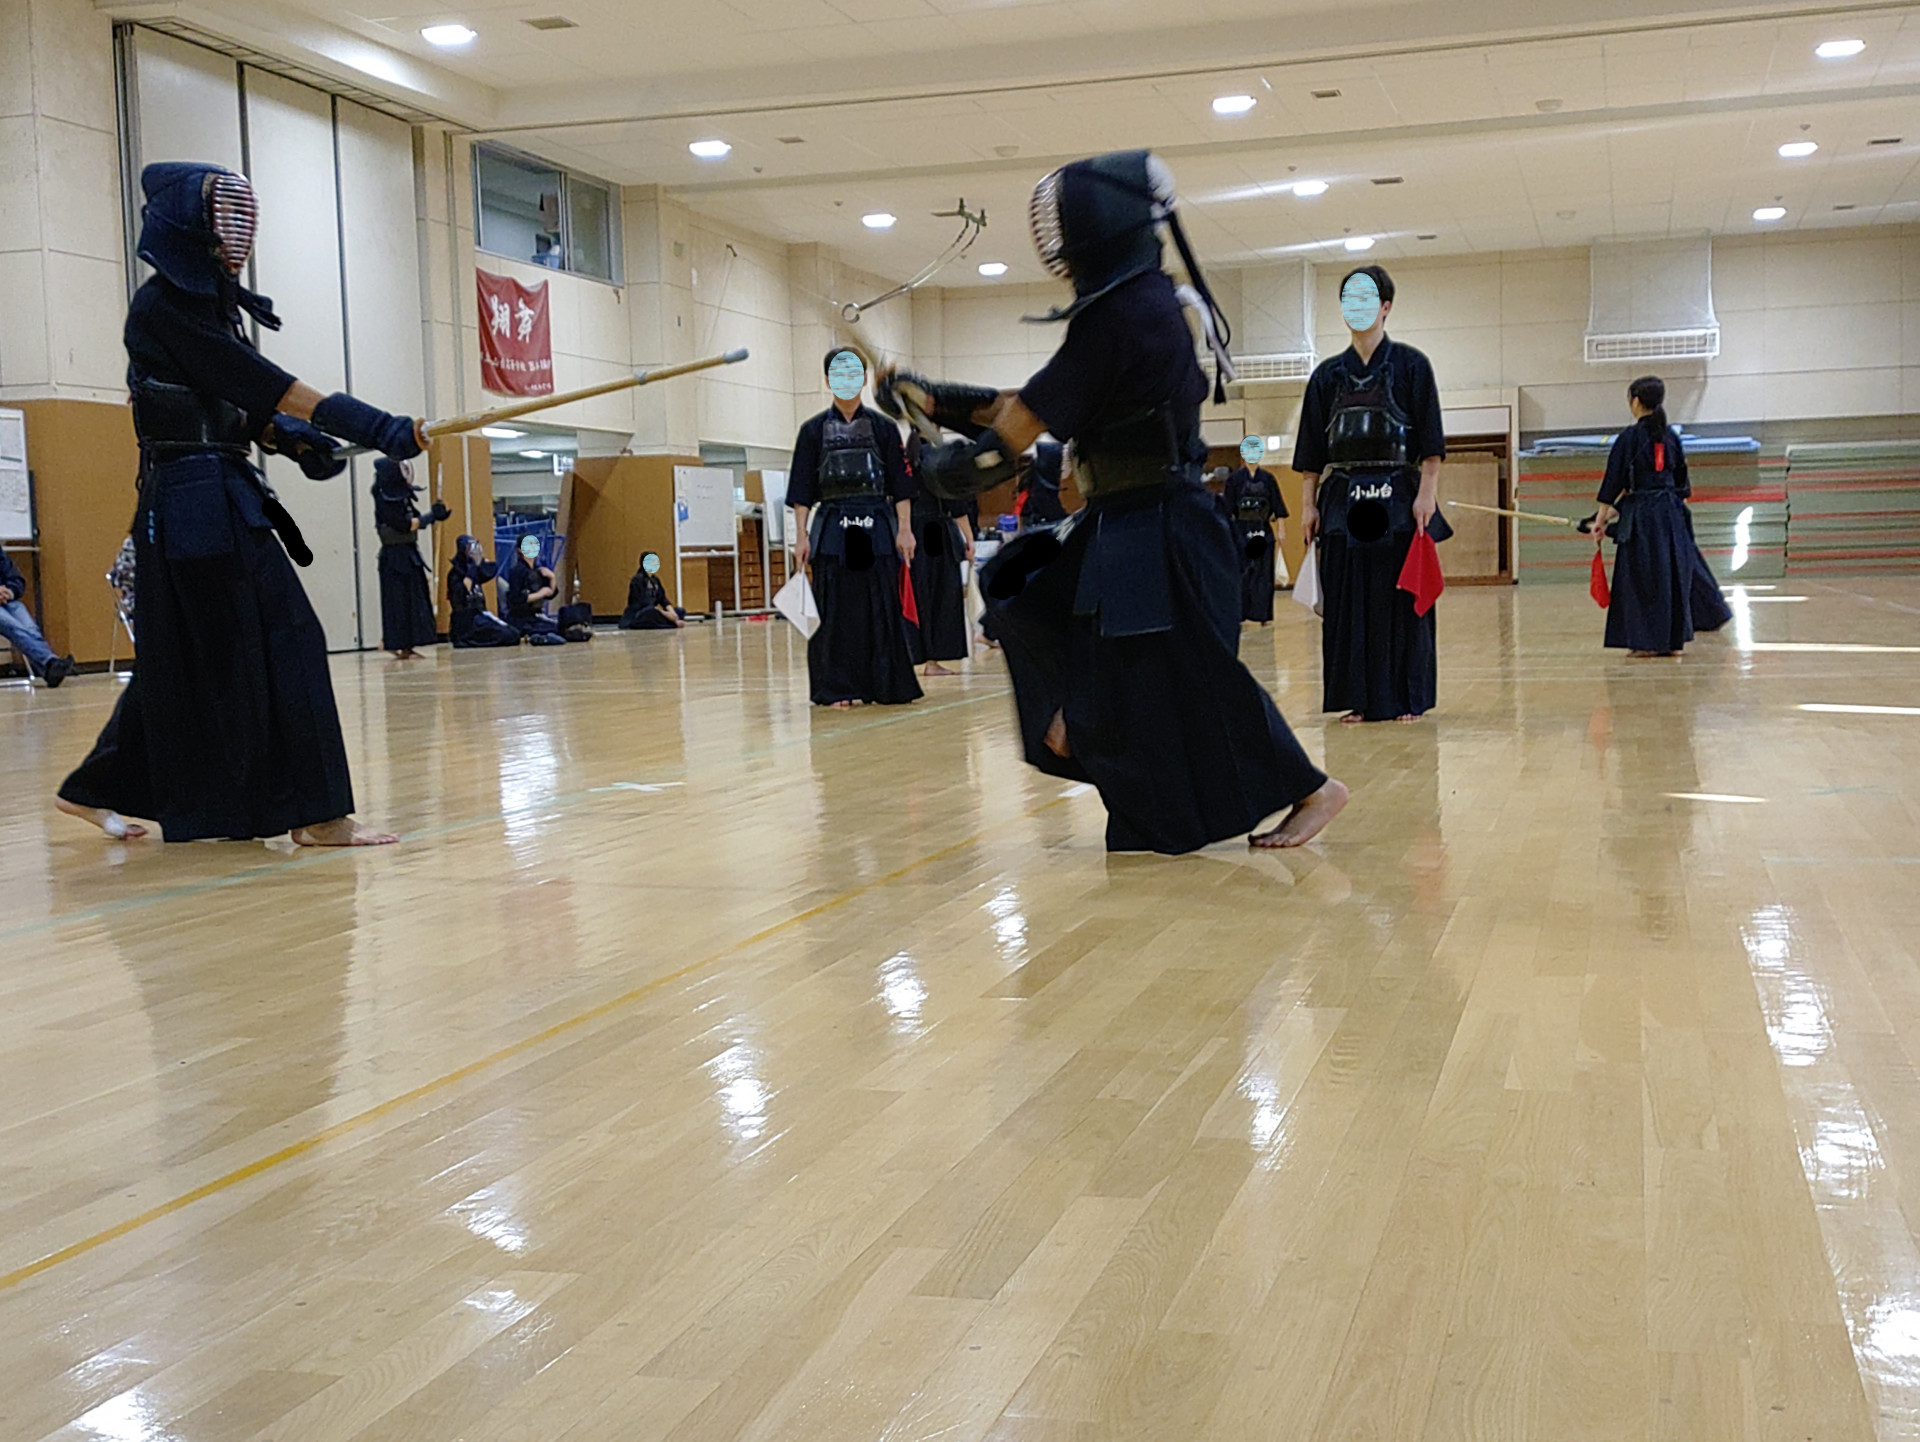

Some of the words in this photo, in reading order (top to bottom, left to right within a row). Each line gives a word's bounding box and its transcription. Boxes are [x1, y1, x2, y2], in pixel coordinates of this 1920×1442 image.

[1350, 482, 1393, 501] 小山台
[839, 515, 874, 528] 小山台
